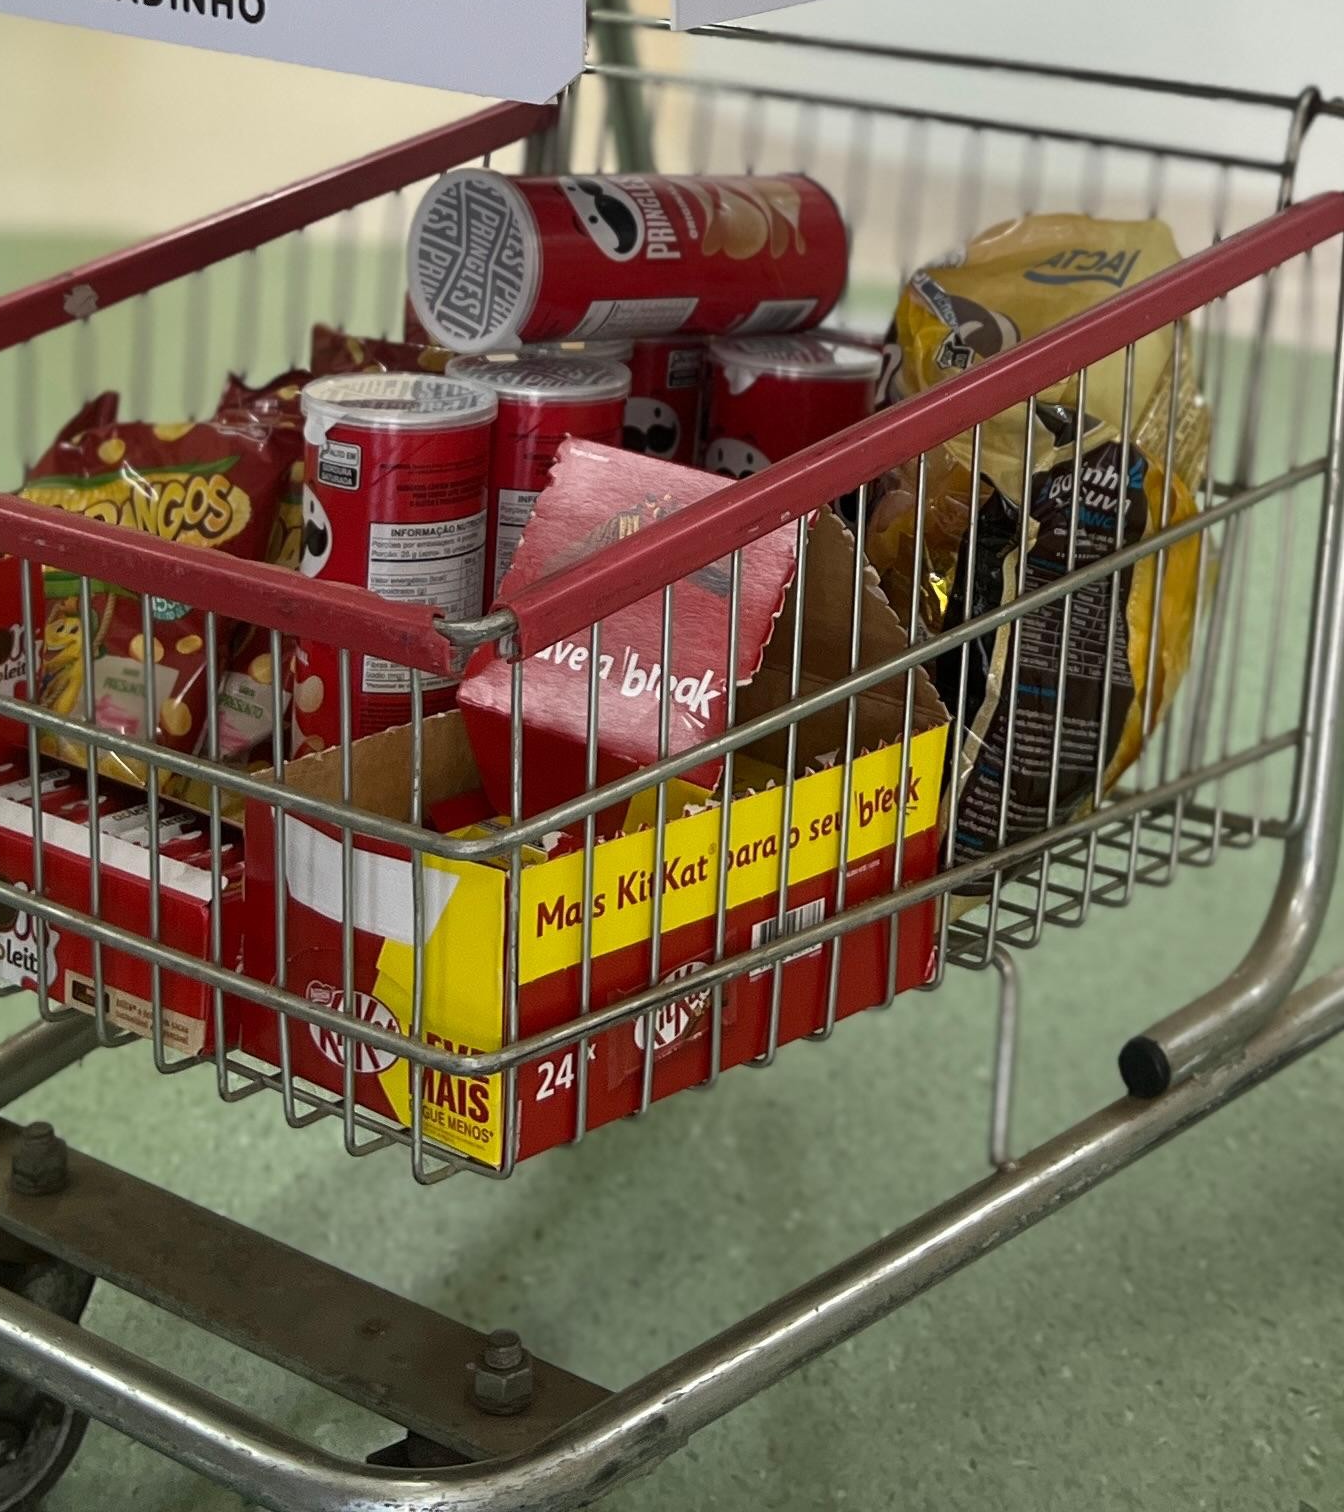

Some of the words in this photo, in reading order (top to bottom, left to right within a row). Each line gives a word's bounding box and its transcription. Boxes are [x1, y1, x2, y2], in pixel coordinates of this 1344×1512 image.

[450, 200, 500, 321] PRINGLES
[390, 524, 455, 537] INFORMAÇÃO
[4, 661, 27, 682] leit
[537, 893, 606, 938] Mas
[6, 940, 39, 975] leit
[535, 1052, 575, 1102] 24
